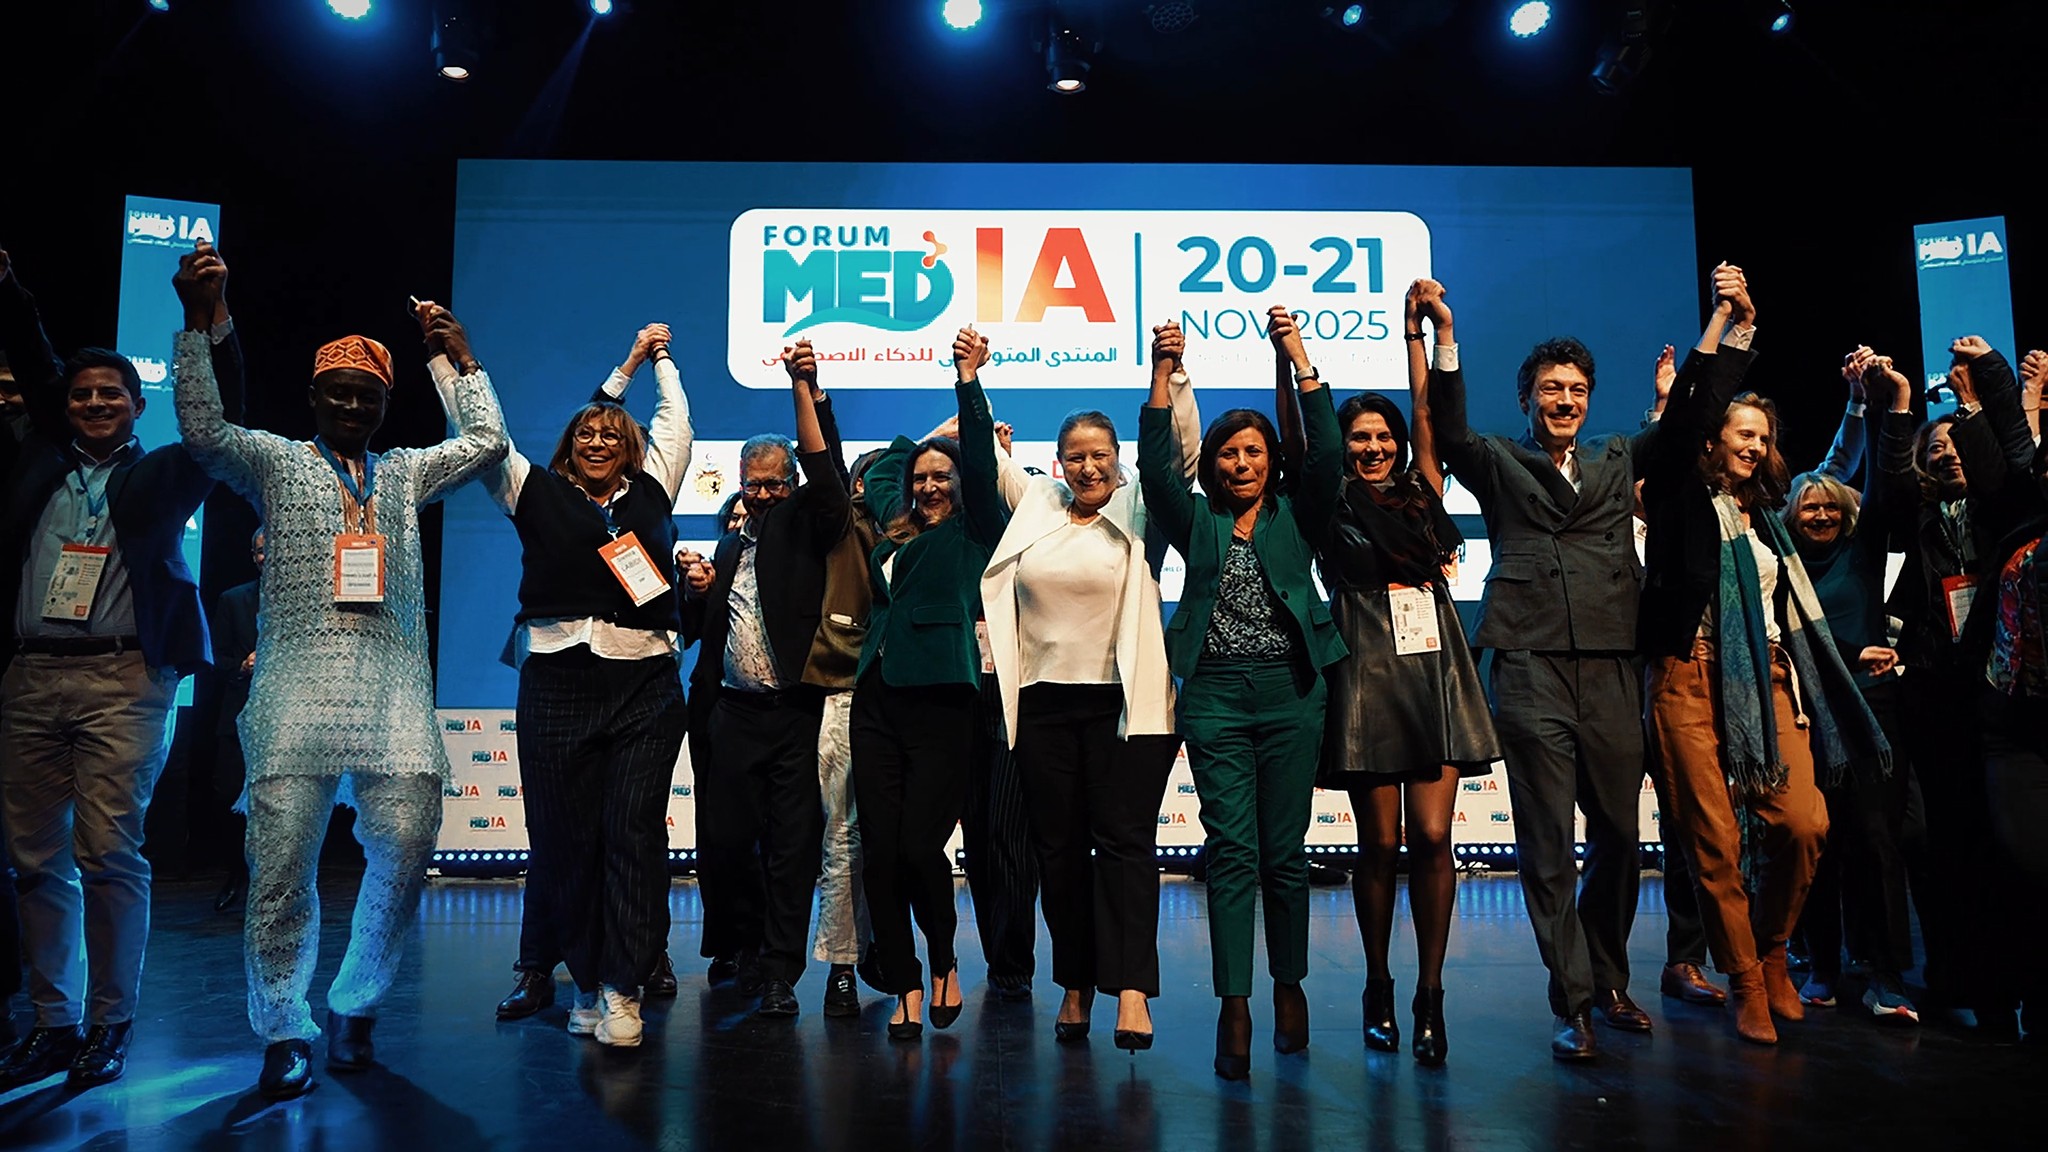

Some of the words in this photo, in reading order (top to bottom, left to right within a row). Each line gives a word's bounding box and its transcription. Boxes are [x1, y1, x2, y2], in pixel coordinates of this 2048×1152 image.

[764, 225, 890, 247] FORUM
[763, 249, 955, 336] MED
[976, 227, 1116, 322] IA
[1177, 236, 1383, 293] 20-21
[1181, 309, 1271, 340] NOV
[1291, 309, 1389, 341] 2025
